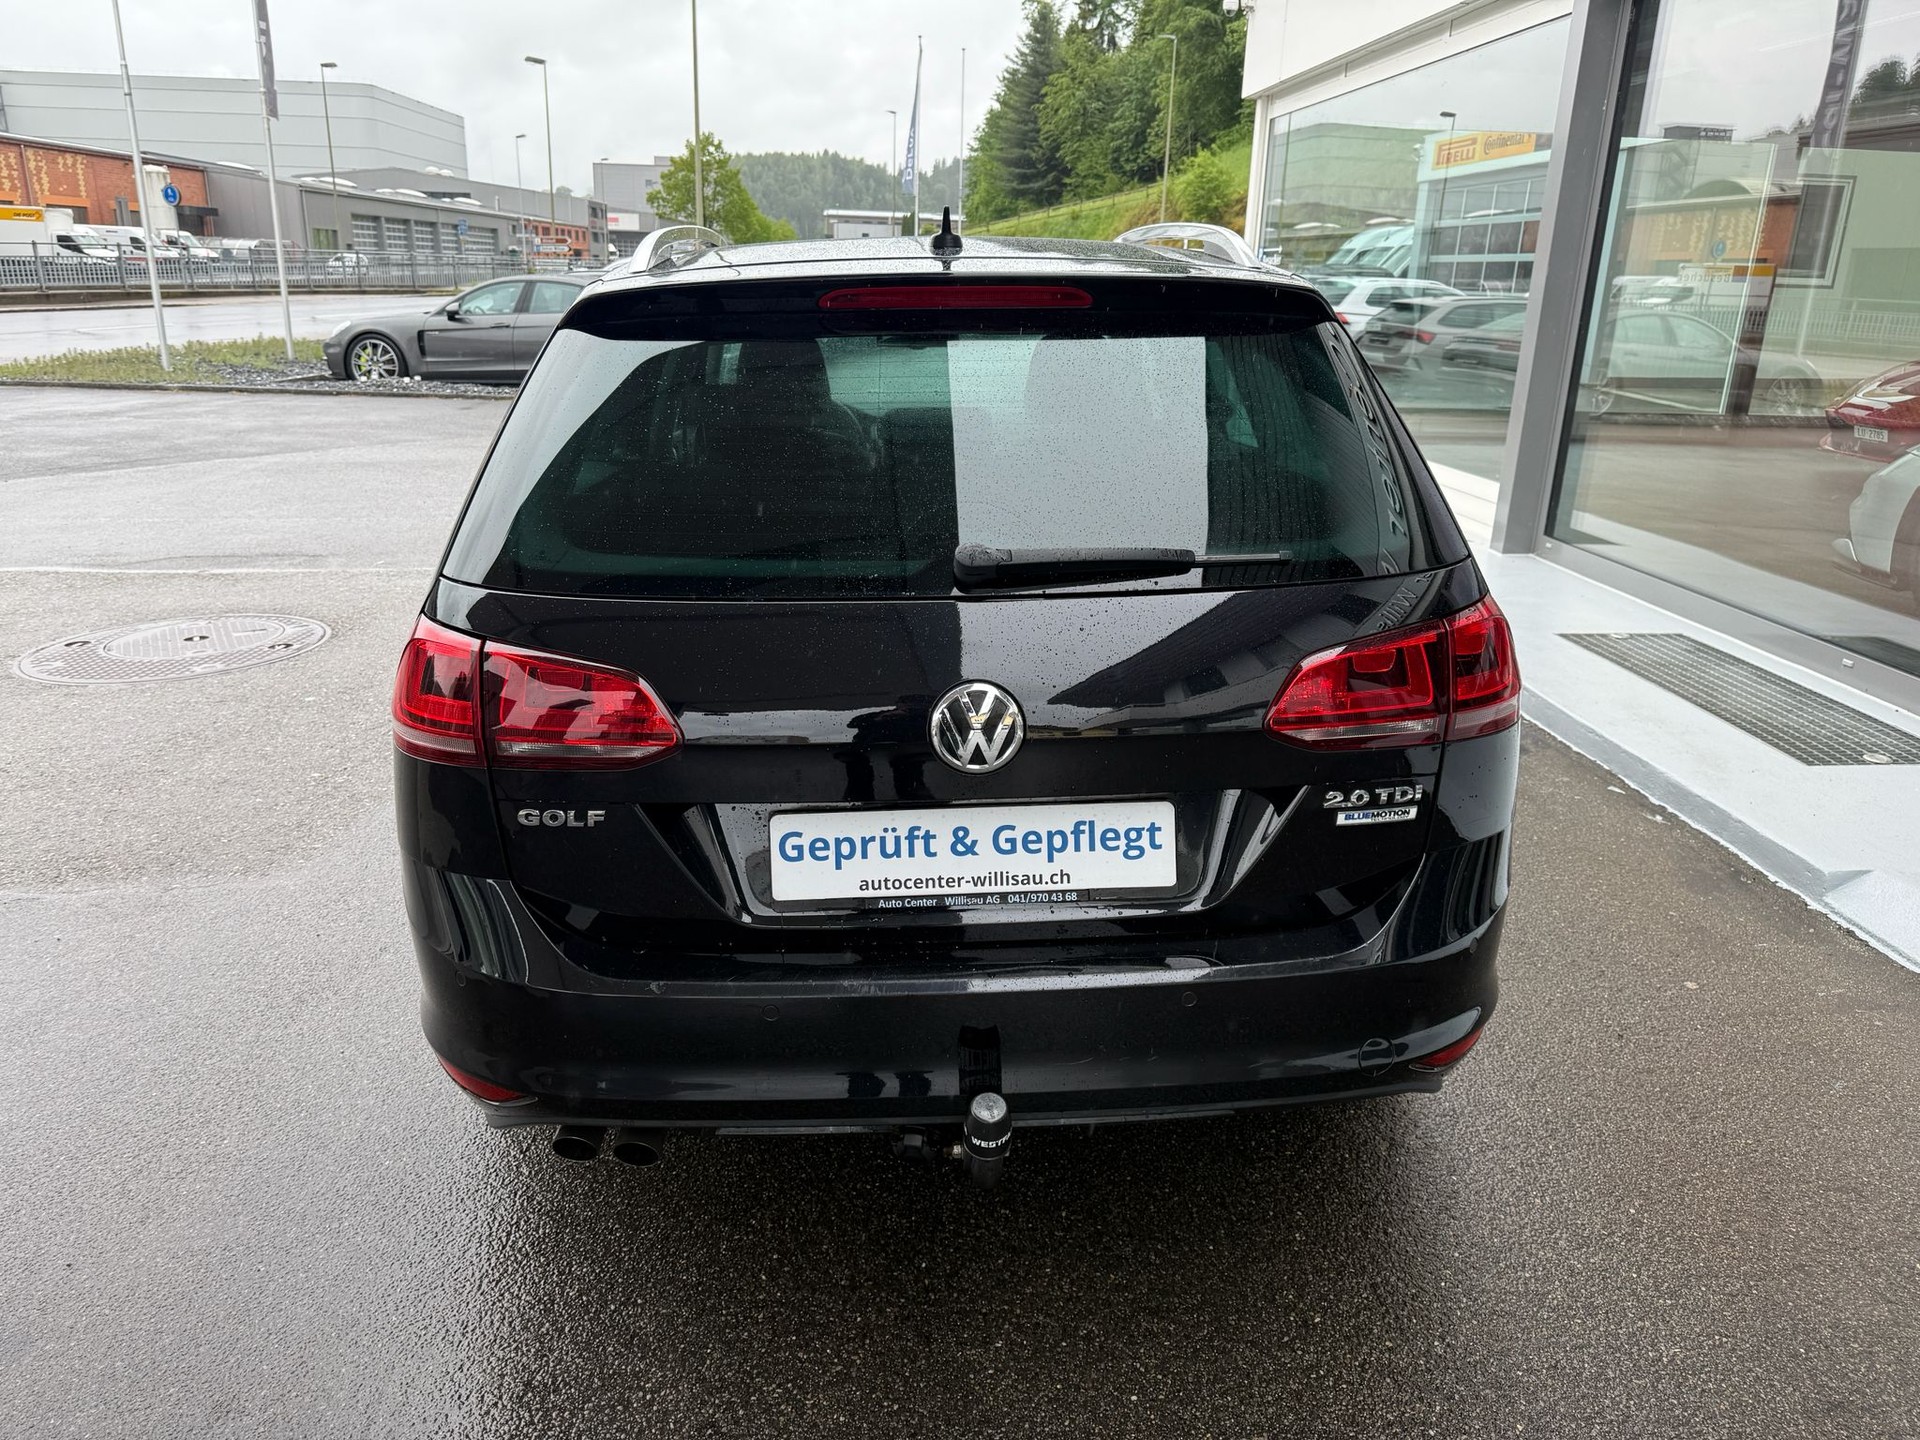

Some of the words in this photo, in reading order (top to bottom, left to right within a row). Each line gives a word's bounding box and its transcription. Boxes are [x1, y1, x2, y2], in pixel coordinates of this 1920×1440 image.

[1436, 137, 1478, 166] PIRELLI
[1484, 132, 1525, 155] Continental
[932, 684, 1022, 772] VW
[1323, 788, 1370, 809] 2.0
[1375, 784, 1423, 805] TDI
[517, 808, 606, 828] GOLF
[1343, 808, 1411, 821] BLUEMOTION
[778, 825, 938, 871] Geprüft
[949, 825, 979, 857] &
[991, 820, 1163, 864] Gepflegt
[858, 868, 1071, 892] autocenter-willisau.ch
[878, 898, 903, 909] Auto
[904, 897, 937, 909] Center
[944, 895, 984, 907] Willisau
[986, 895, 1001, 905] AG
[1007, 892, 1049, 904] 041/970
[1050, 892, 1064, 902] 43
[1065, 891, 1078, 902] 68
